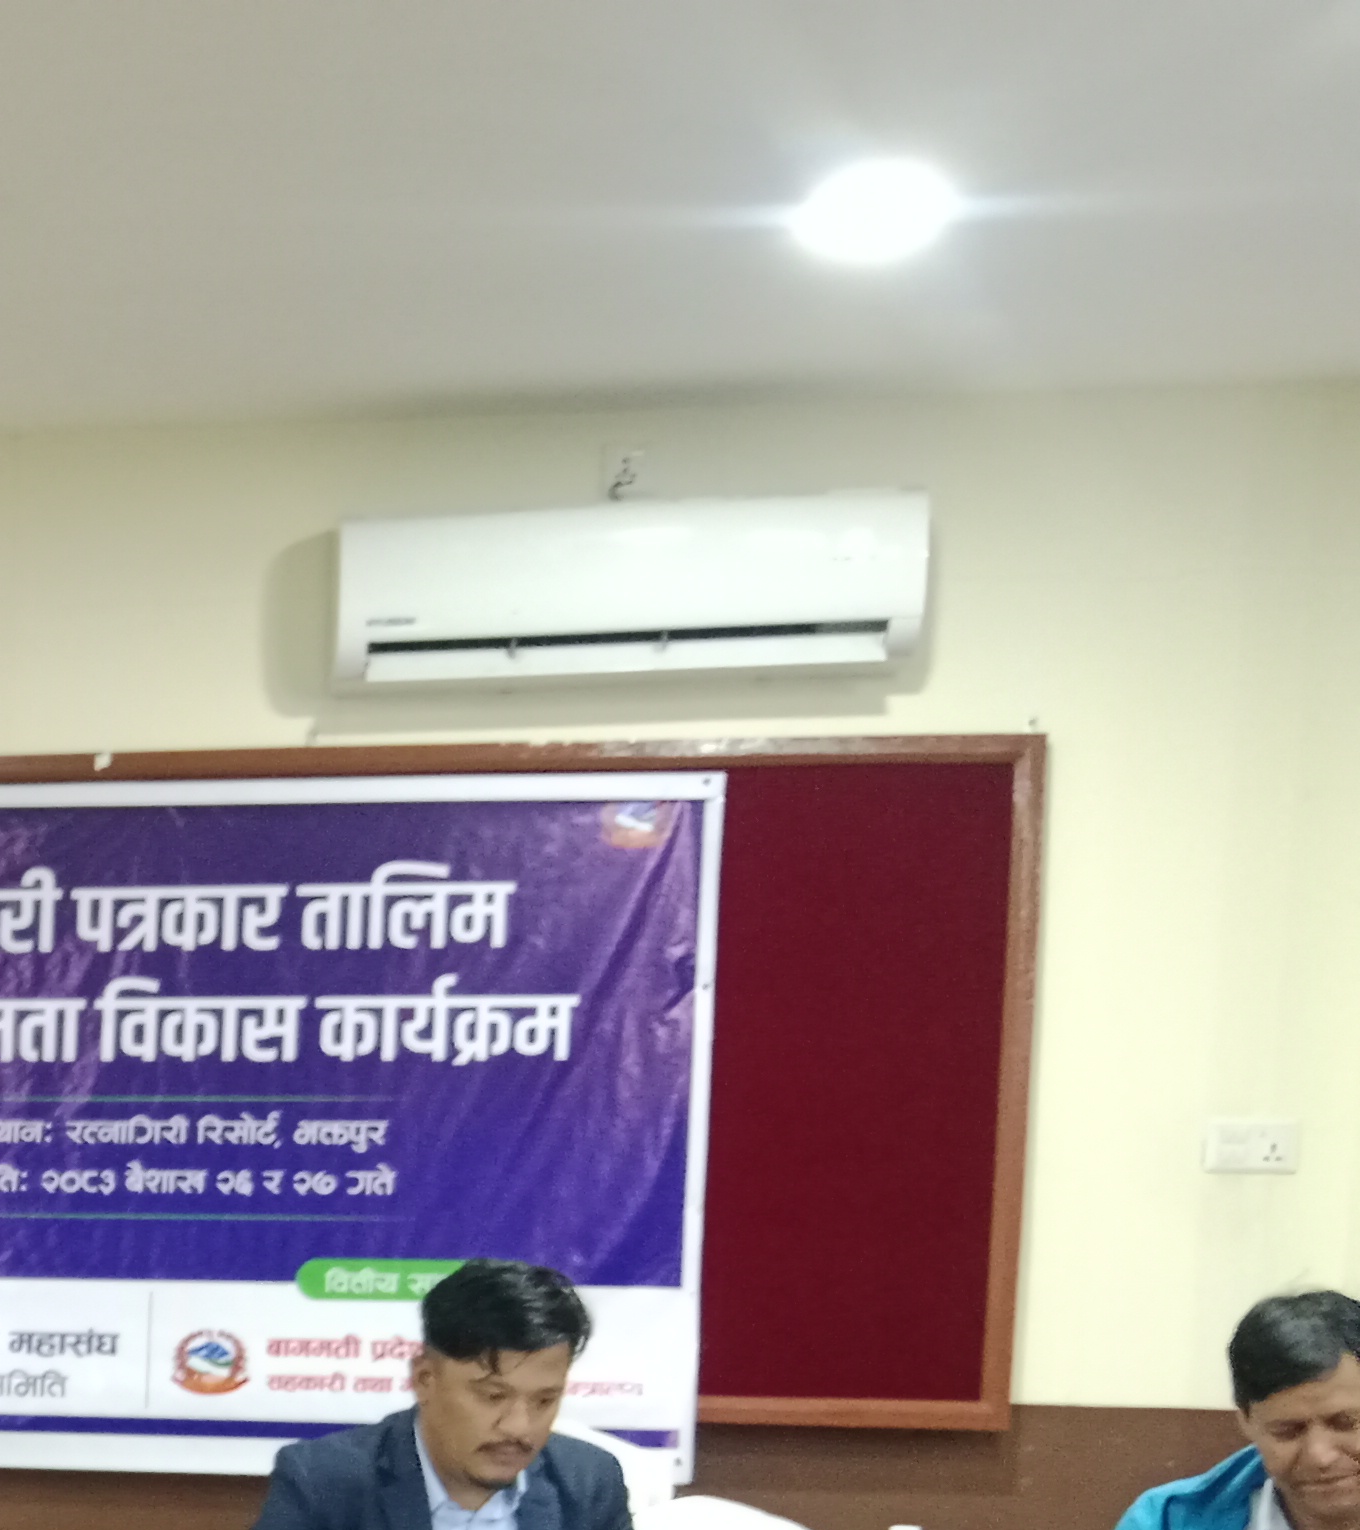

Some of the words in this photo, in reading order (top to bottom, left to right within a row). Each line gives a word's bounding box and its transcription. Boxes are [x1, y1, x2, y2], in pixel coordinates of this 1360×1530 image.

[71, 882, 288, 952] पत्रकार
[295, 860, 517, 951] तालिम
[93, 976, 307, 1062] विकास
[314, 973, 580, 1066] कार्यक्रम
[65, 1114, 189, 1145] रत्नागिरी
[197, 1109, 283, 1149] रिसोर्ट,
[292, 1119, 390, 1153] भक्तपुर
[40, 1170, 117, 1196] २०८३
[124, 1158, 208, 1196] बैशाख
[215, 1170, 255, 1197] २६
[262, 1170, 284, 1196] र
[292, 1170, 339, 1196] २७
[346, 1162, 398, 1196] गते
[7, 1328, 120, 1357] महासंघ
